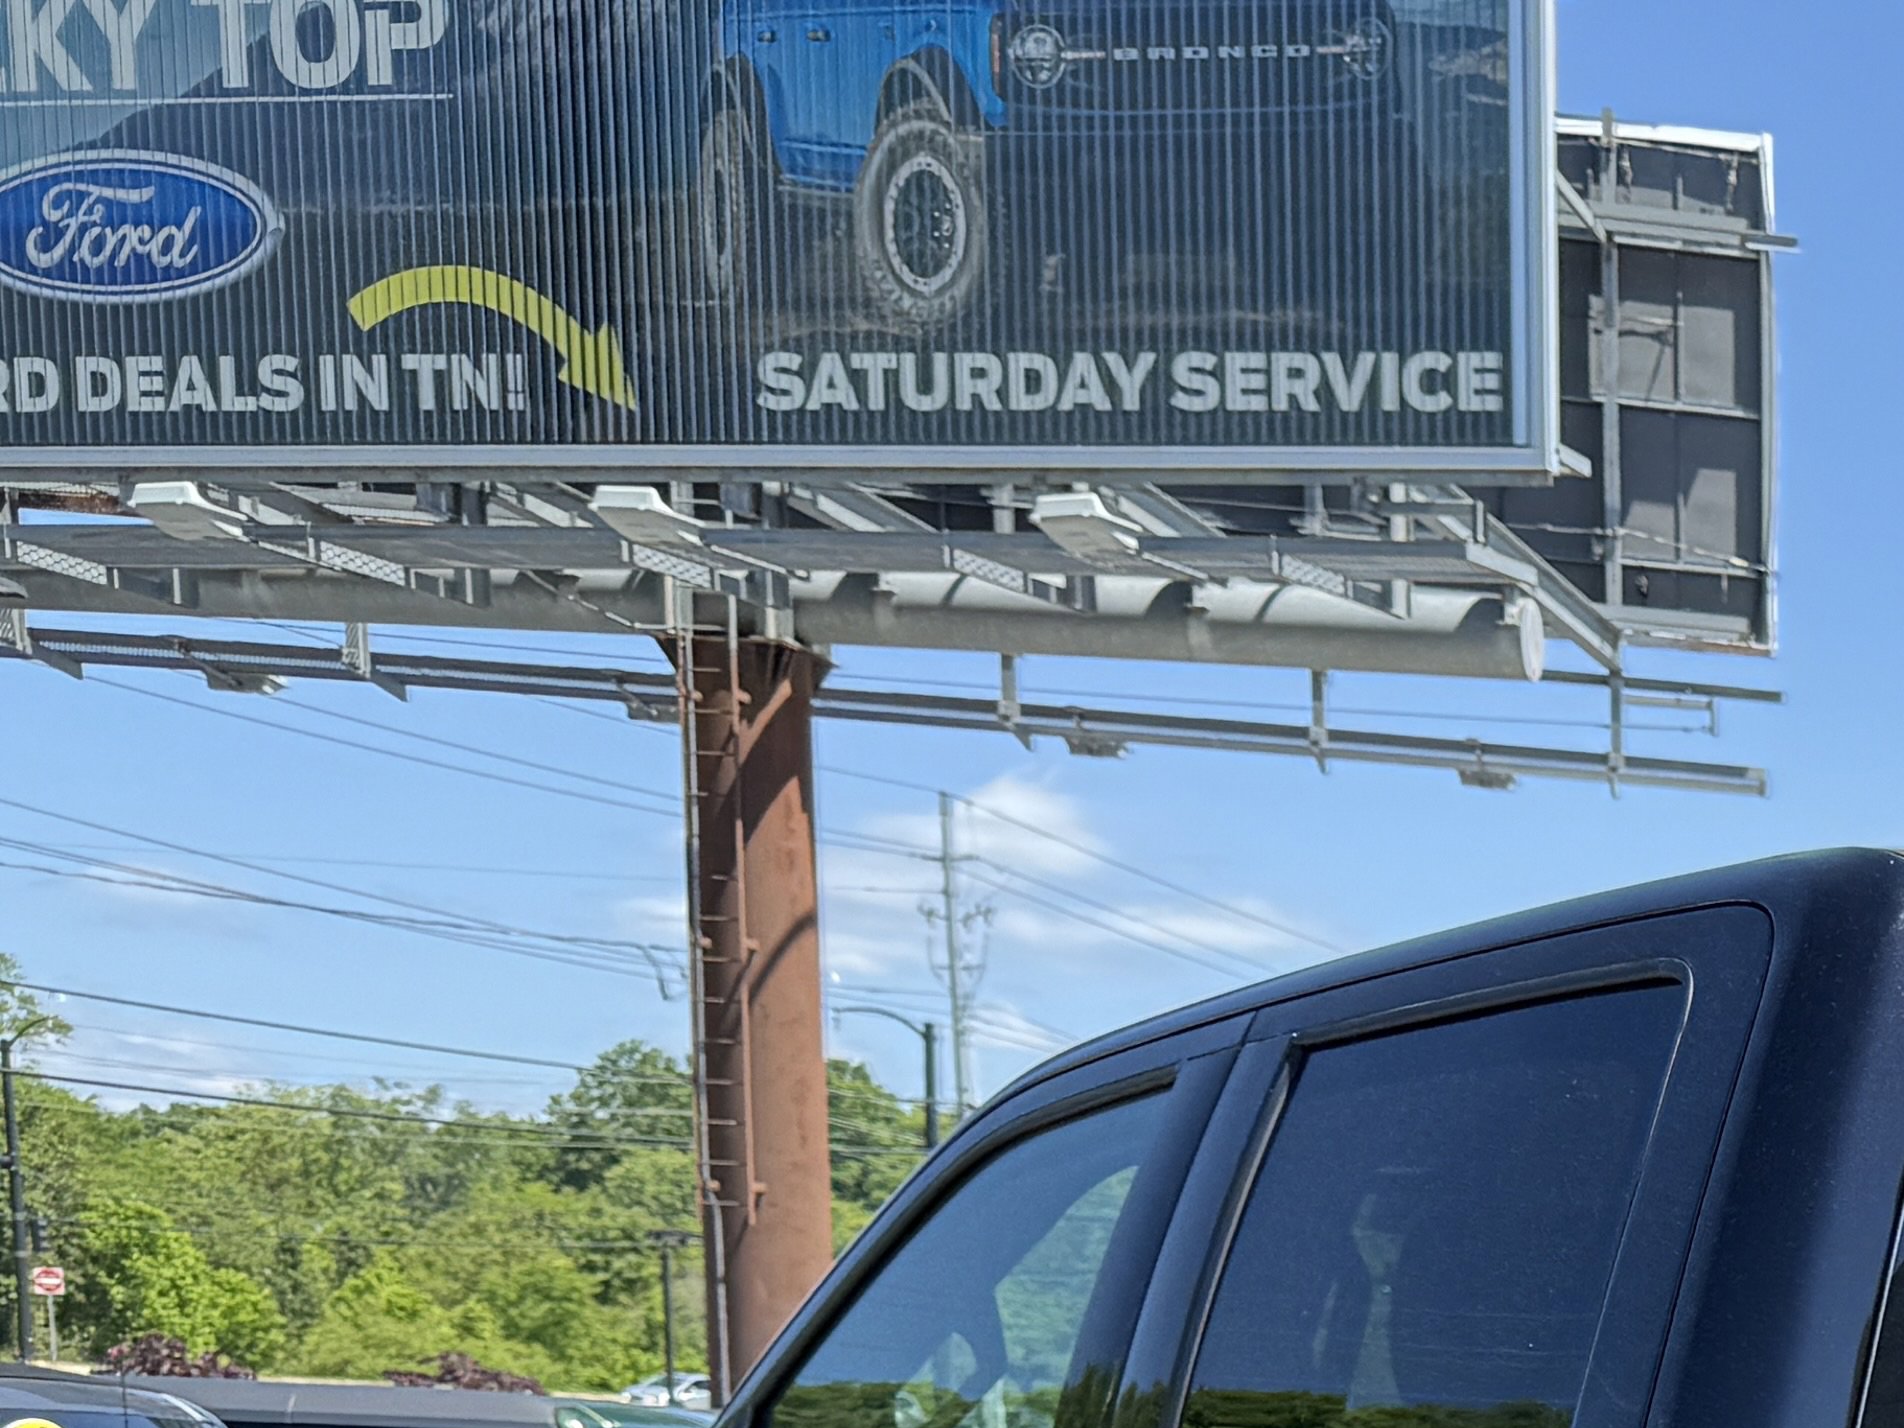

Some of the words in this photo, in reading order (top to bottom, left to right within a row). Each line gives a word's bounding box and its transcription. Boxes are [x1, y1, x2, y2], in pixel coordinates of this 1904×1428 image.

[0, 0, 154, 93] KY
[190, 0, 449, 90] TOP
[1113, 45, 1310, 61] BRONCO
[25, 181, 203, 269] Ford
[0, 355, 60, 413] D
[75, 353, 305, 413] DEALS
[319, 353, 390, 412] IN
[401, 352, 526, 412] TN!
[756, 351, 1157, 413] SATURDAY
[1169, 351, 1504, 413] SERVICE
